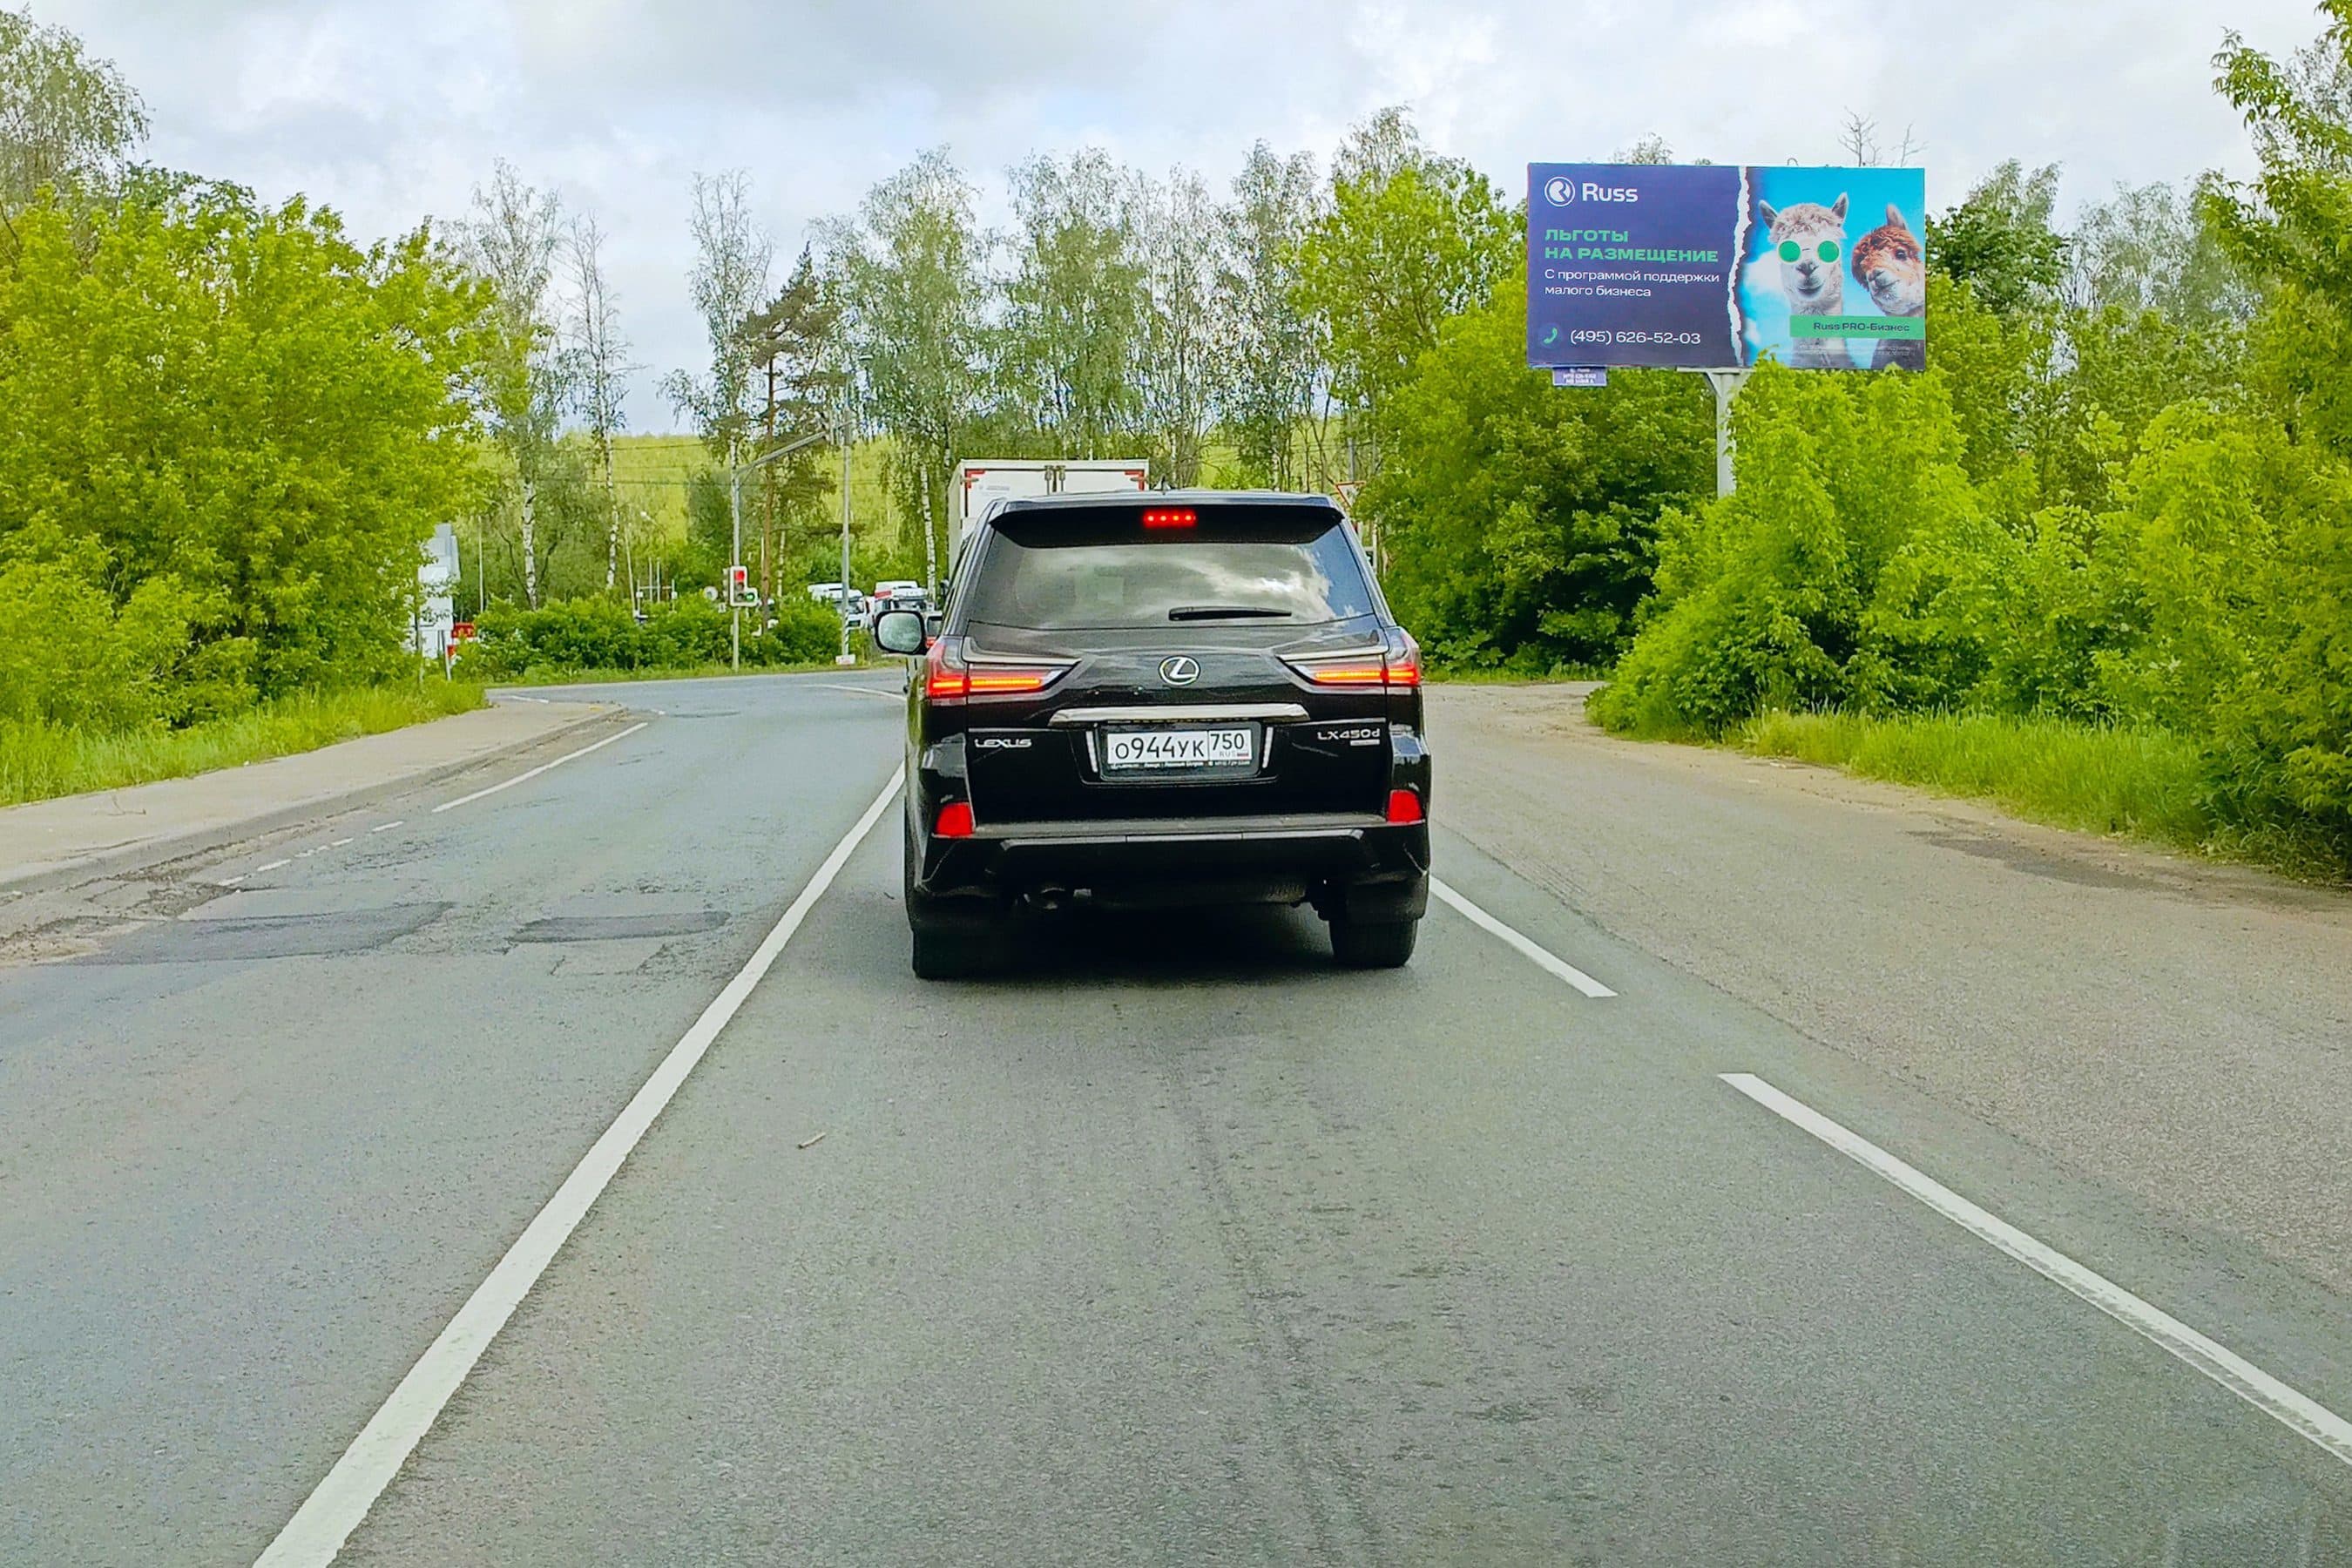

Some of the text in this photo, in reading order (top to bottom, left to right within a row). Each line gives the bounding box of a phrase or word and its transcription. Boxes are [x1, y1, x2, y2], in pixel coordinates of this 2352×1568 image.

[1581, 182, 1639, 203] Russ
[1544, 228, 1630, 243] ЛЬГОТЫ
[1544, 247, 1719, 263] НА РАЗМЕЩЕНИЕ
[1544, 268, 1720, 283] С программой поддержки
[1544, 286, 1652, 297] малого бизнеса
[1813, 322, 1910, 332] Russ PRO-Бизнес
[1570, 329, 1701, 346] (495) 626-52-03
[1317, 727, 1381, 740] LX450d
[974, 738, 1032, 748] LEXUS
[1210, 733, 1245, 751] 750
